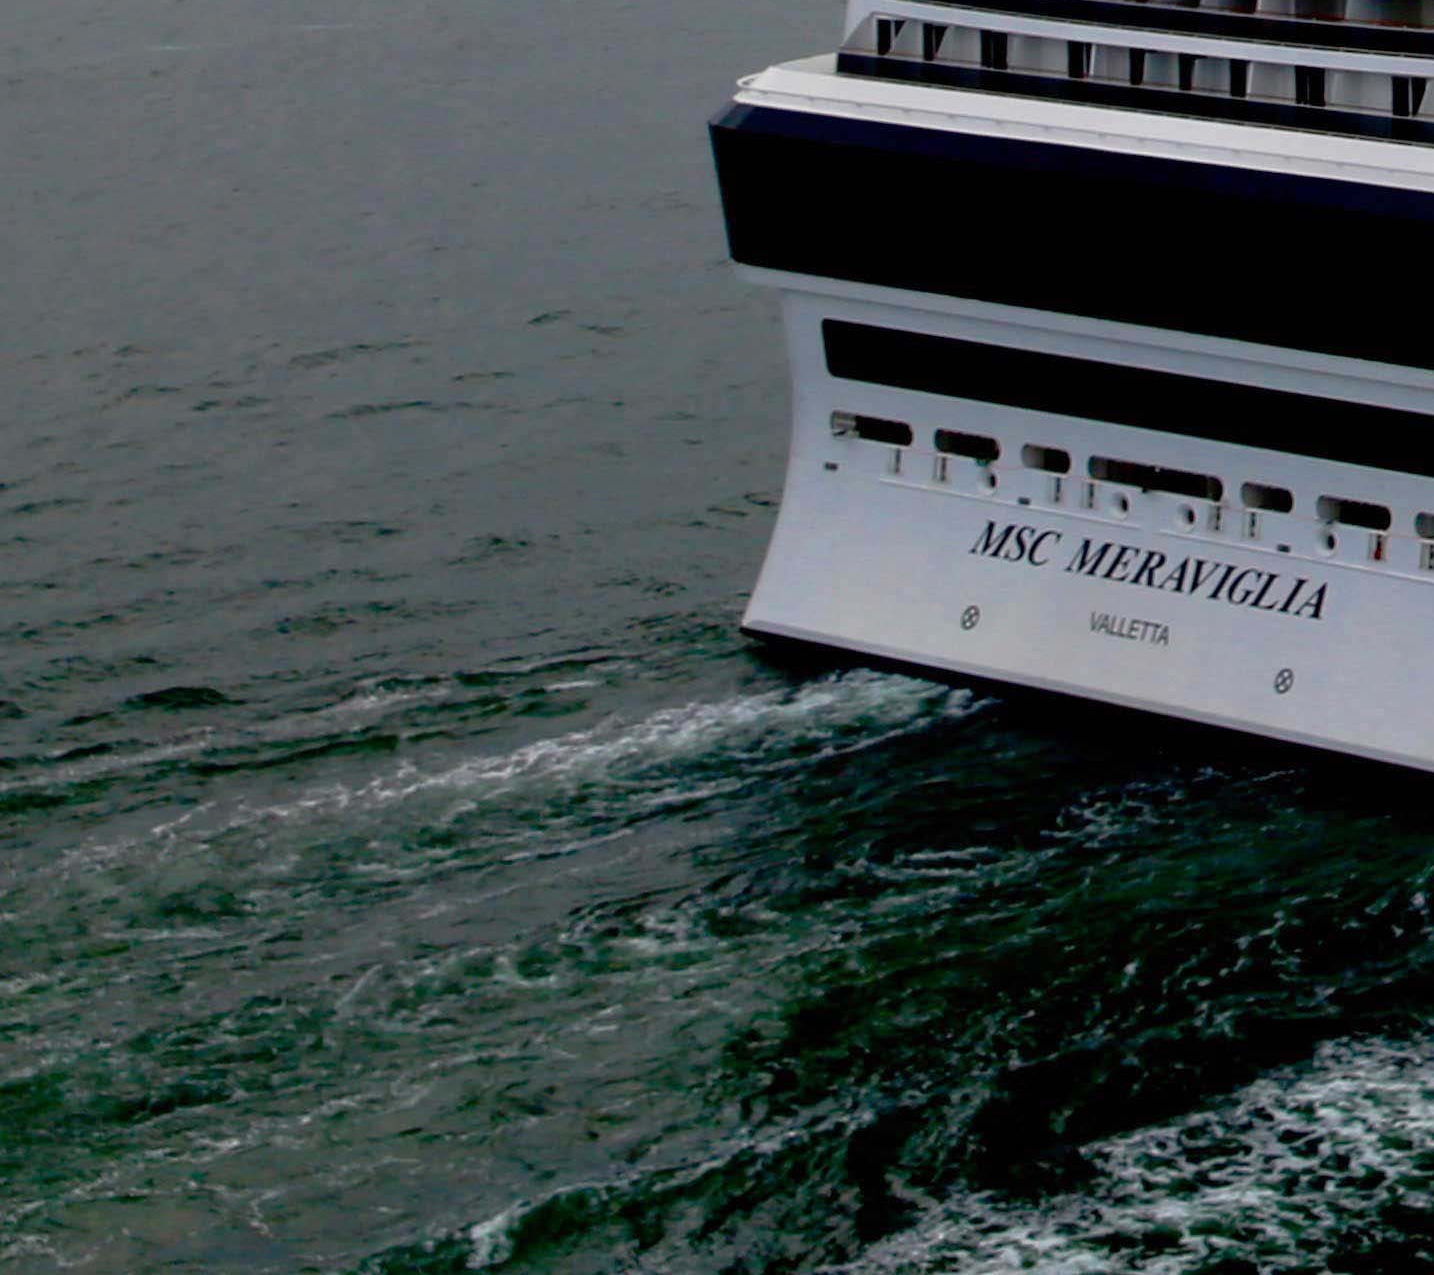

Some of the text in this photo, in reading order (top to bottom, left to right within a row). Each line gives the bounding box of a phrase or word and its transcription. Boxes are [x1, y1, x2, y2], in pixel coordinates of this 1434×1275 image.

[968, 520, 1329, 621] MSC MERAVIGLIA
[1090, 611, 1170, 646] VALLETTA
